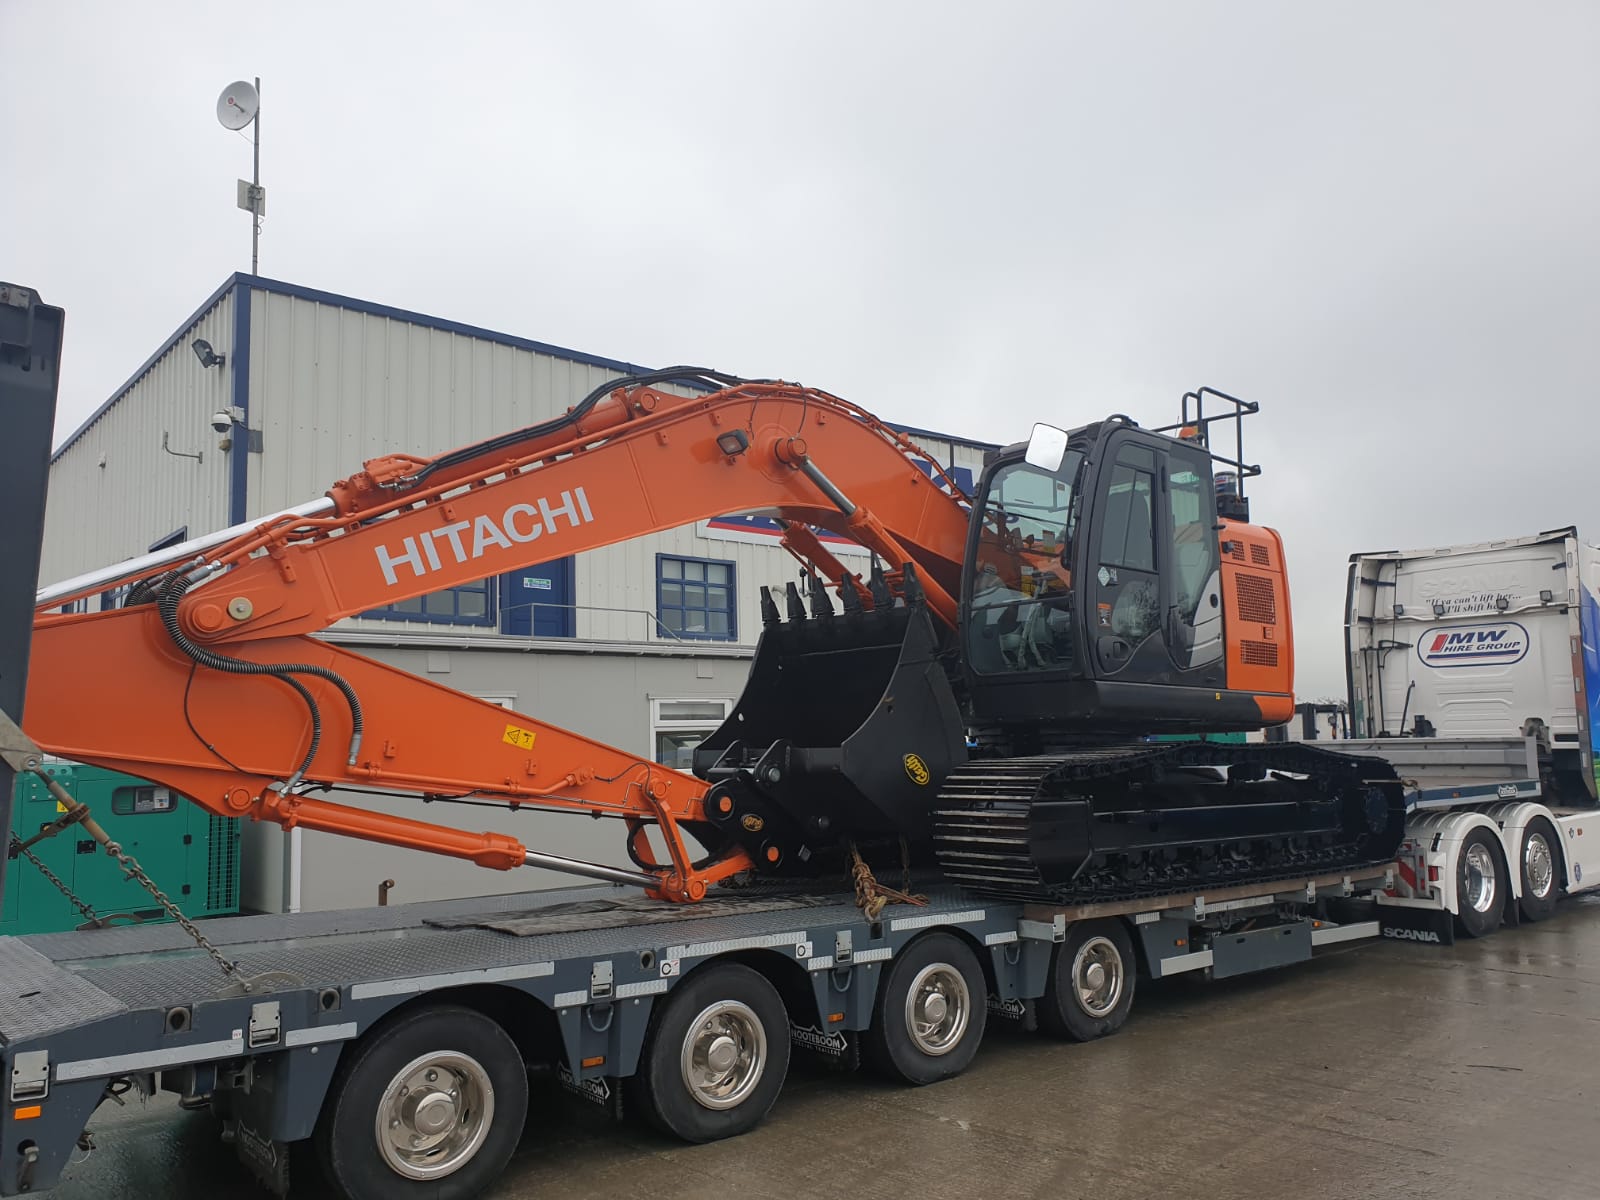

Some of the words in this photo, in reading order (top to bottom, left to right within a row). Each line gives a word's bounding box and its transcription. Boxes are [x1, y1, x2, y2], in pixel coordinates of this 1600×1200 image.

[374, 486, 594, 586] HITACHI
[1454, 595, 1477, 605] can't
[1479, 593, 1495, 603] lift
[1463, 602, 1484, 613] shift
[1444, 644, 1473, 653] HIRE
[1476, 641, 1521, 651] GROUP
[1384, 927, 1440, 942] SCANIA
